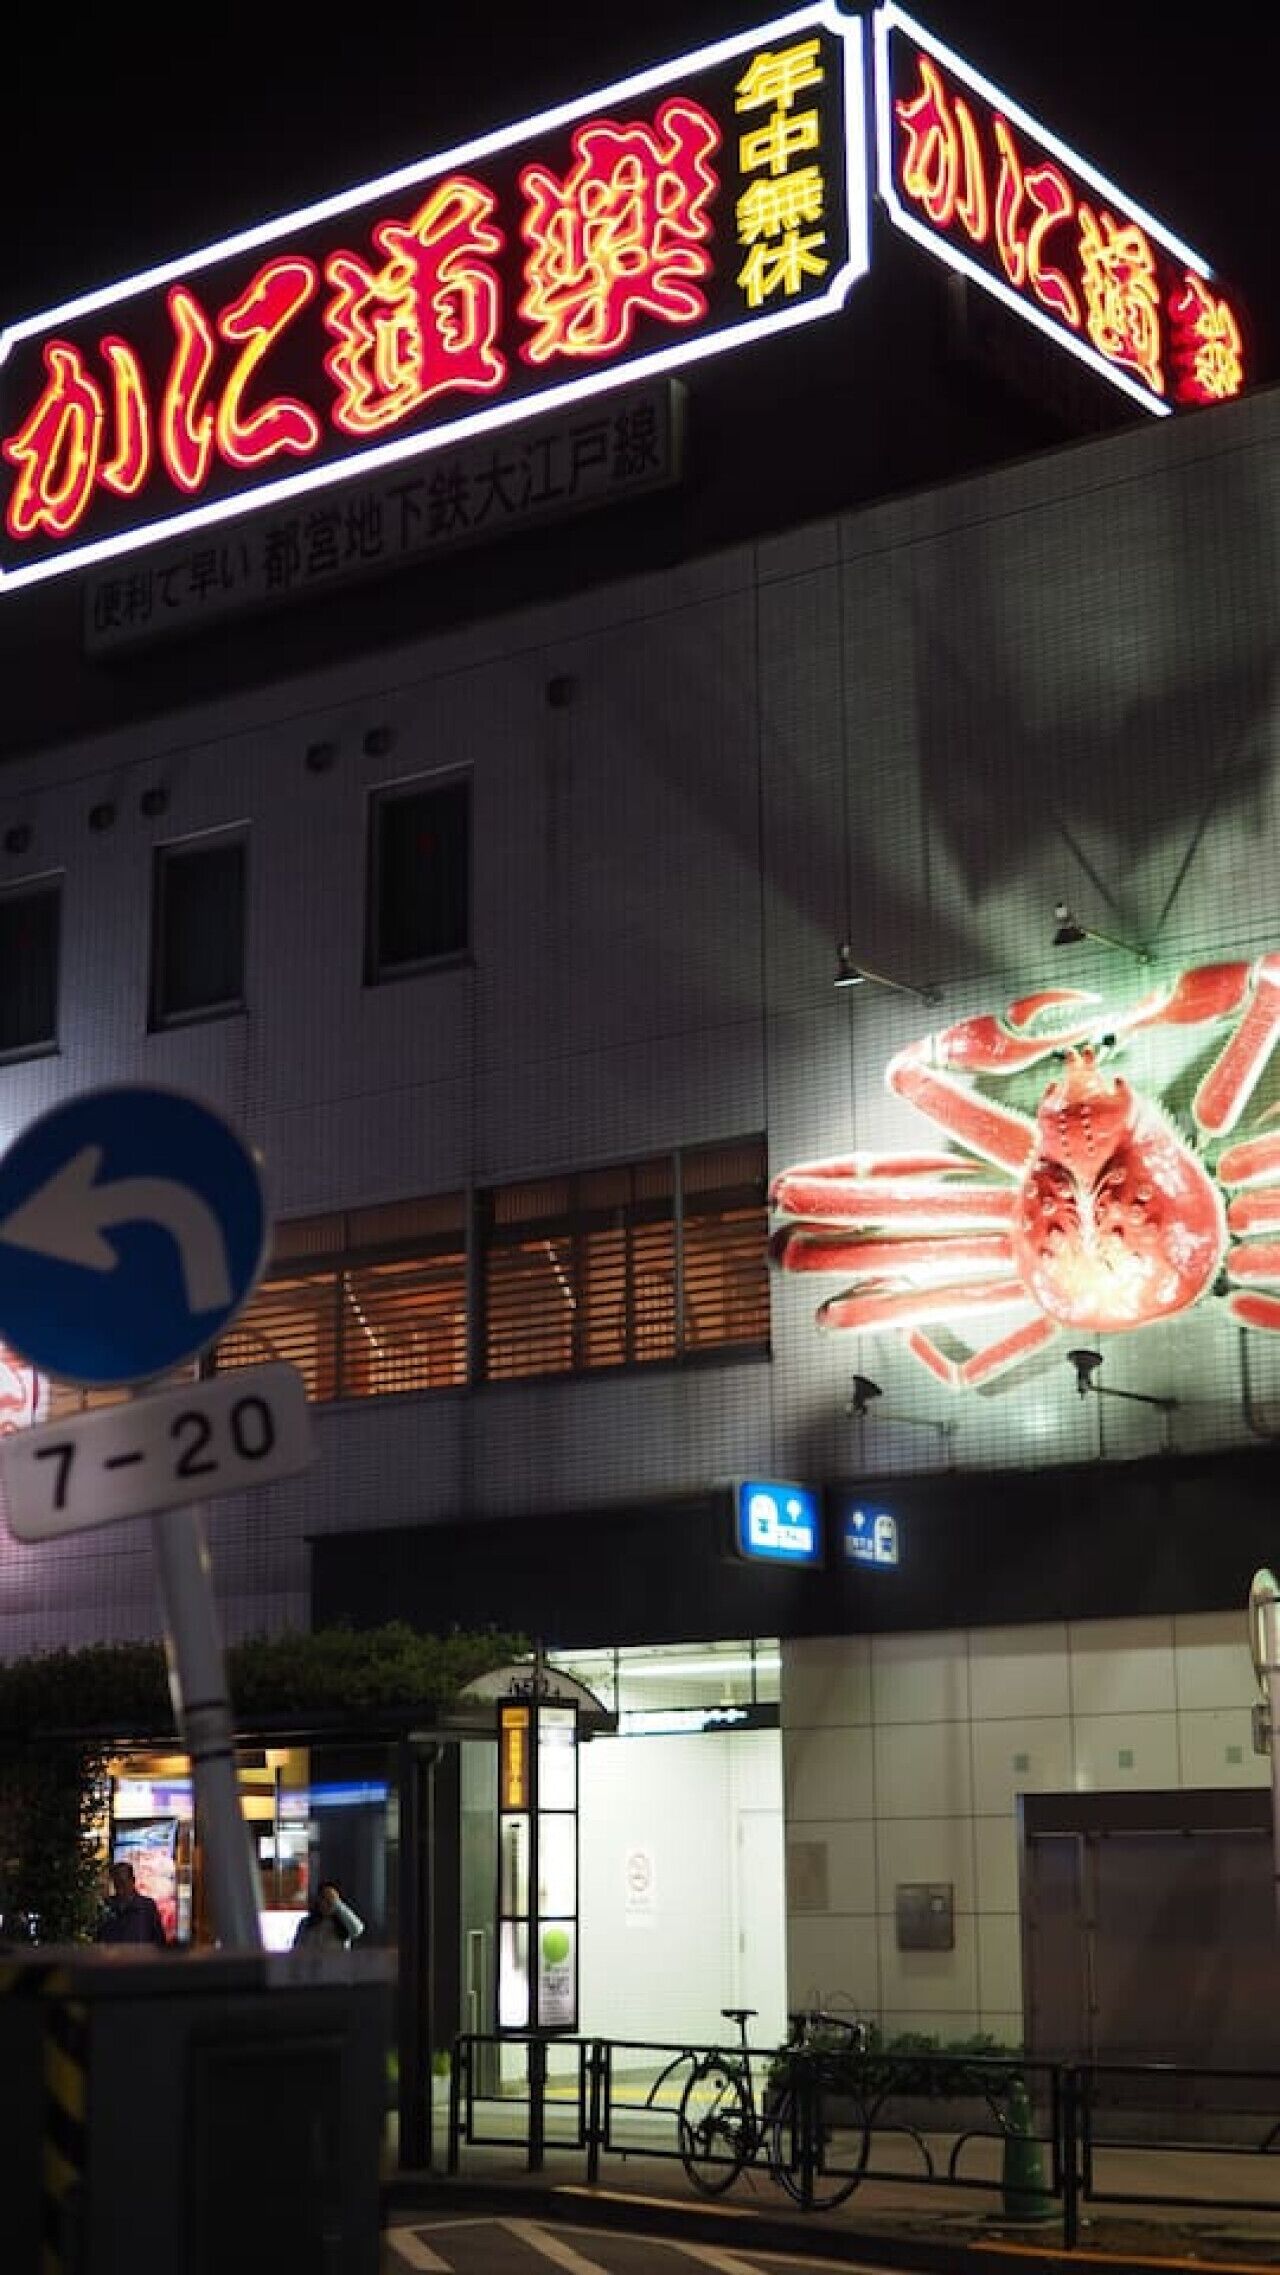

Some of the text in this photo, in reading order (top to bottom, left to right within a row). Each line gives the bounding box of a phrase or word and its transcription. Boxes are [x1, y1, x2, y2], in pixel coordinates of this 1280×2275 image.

[734, 38, 830, 308] 年中無休
[264, 403, 660, 591] 都営地下鉄大江戸線
